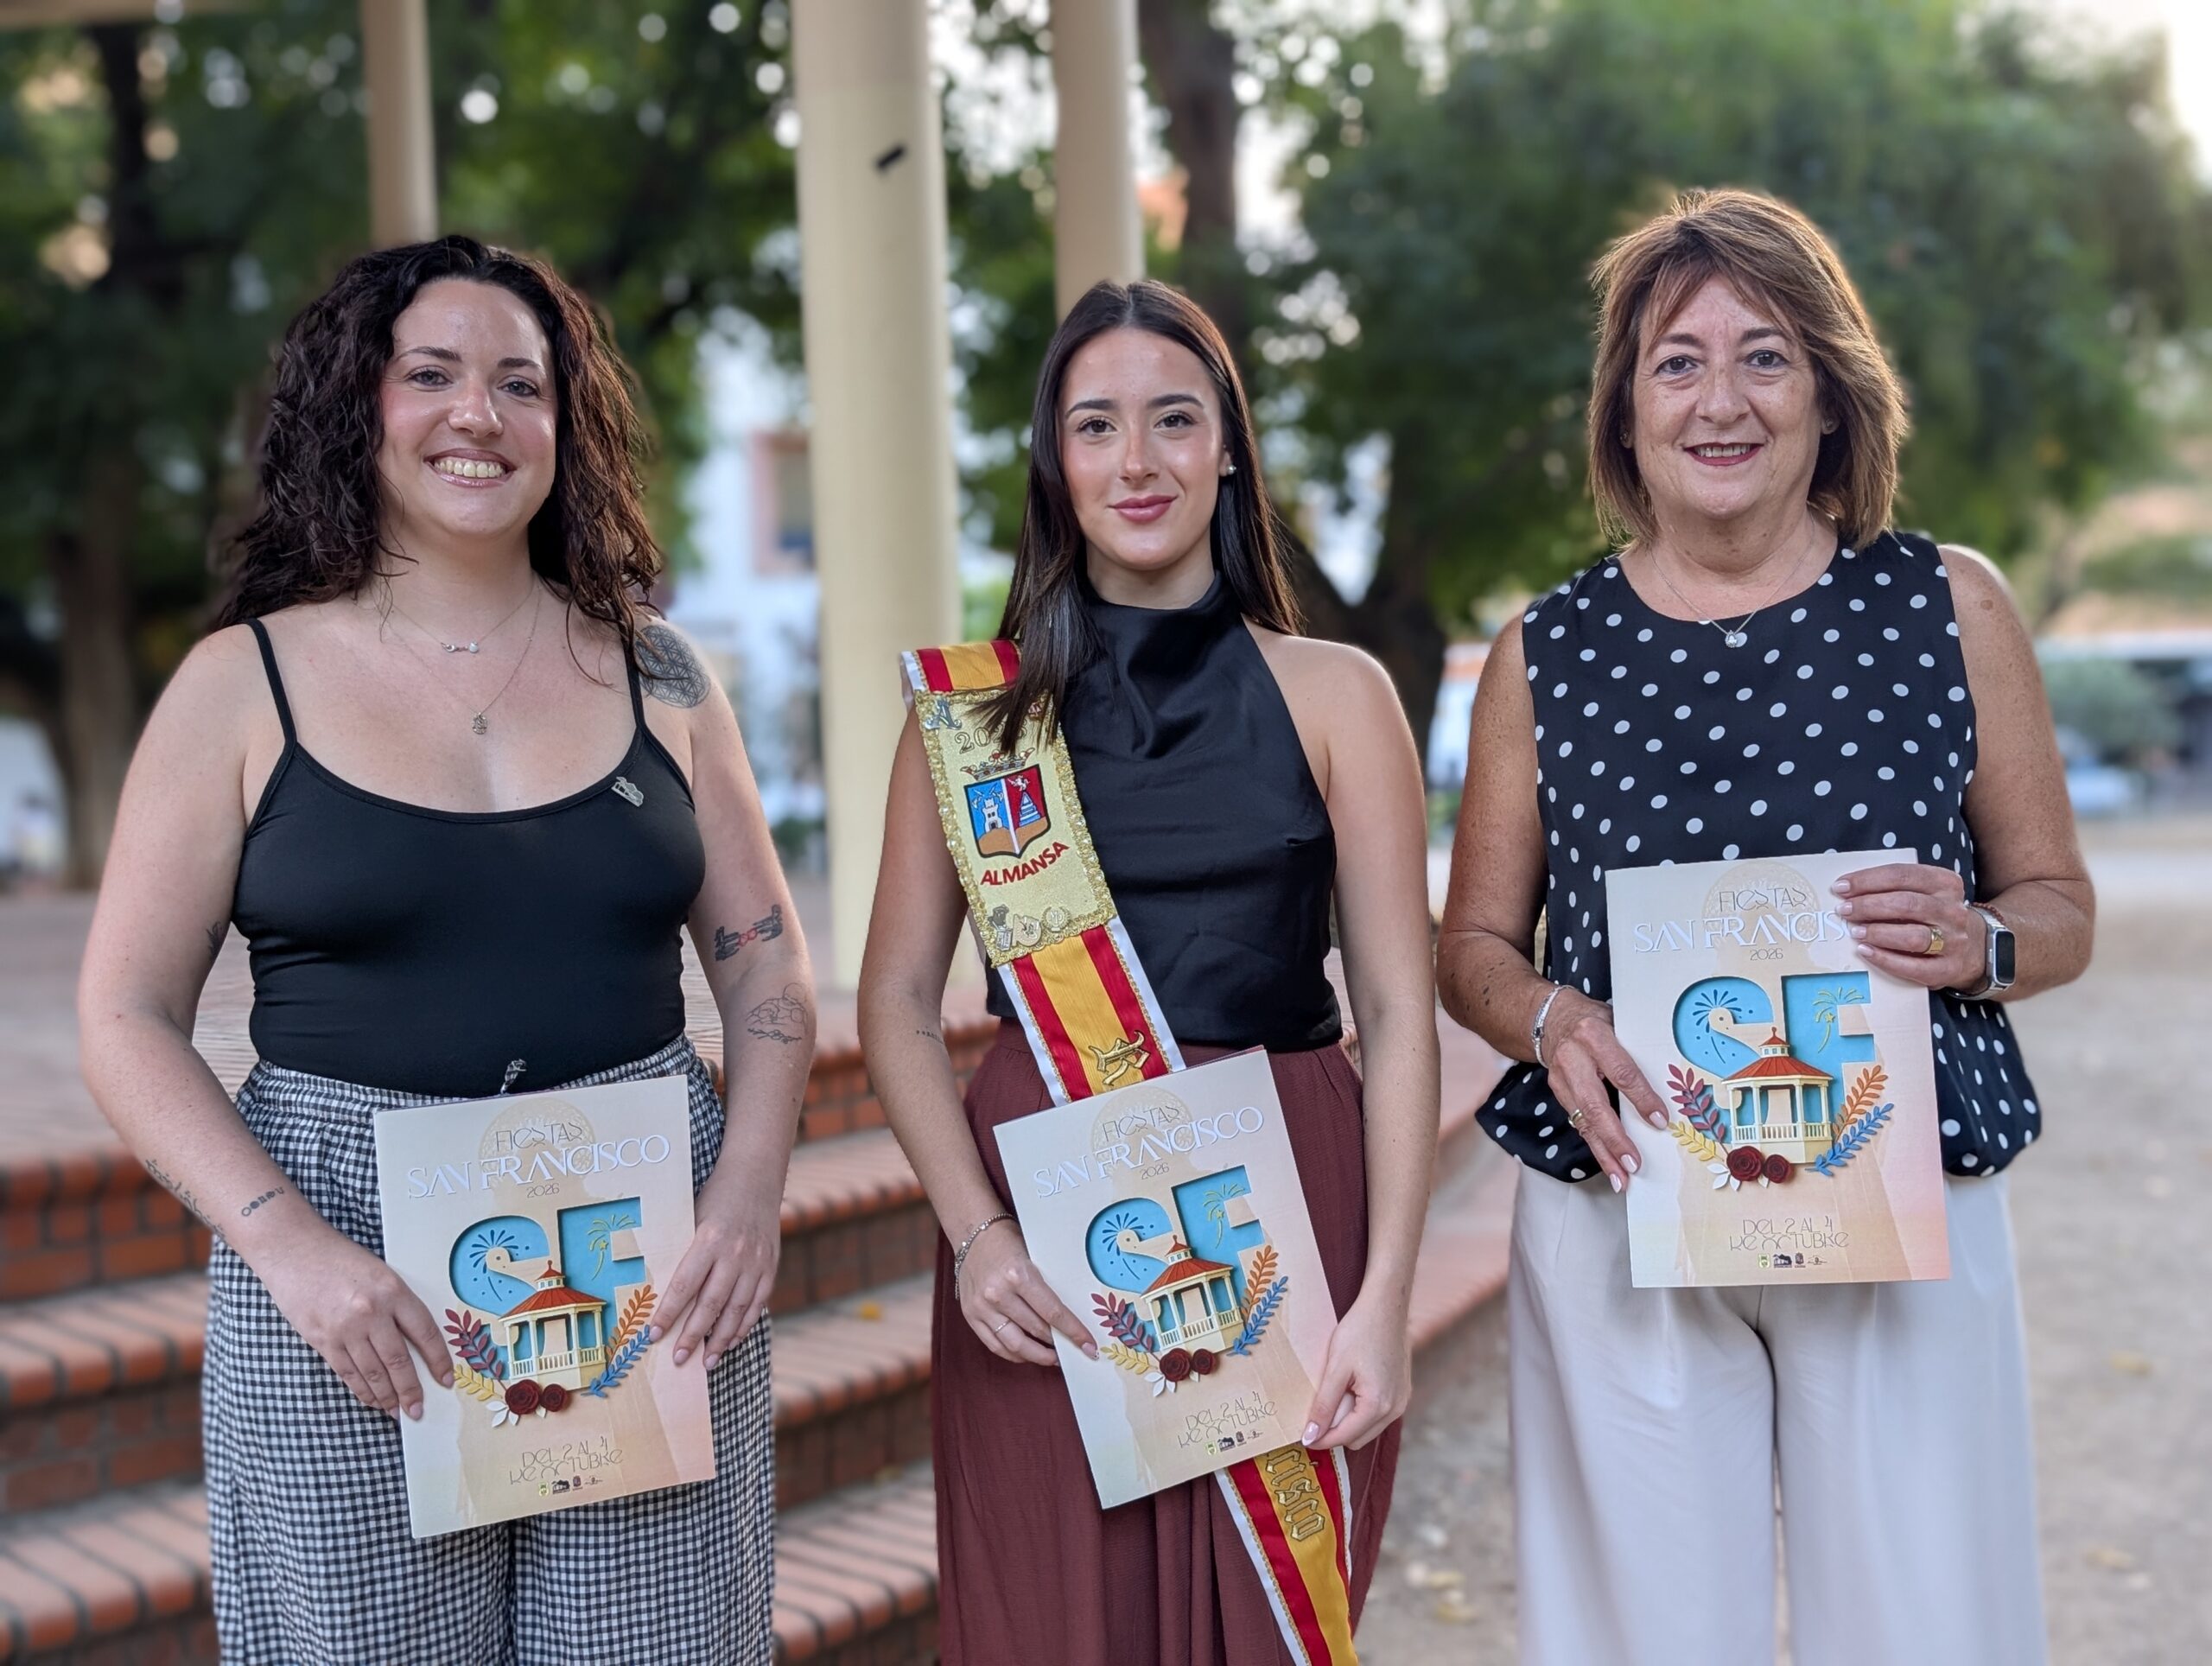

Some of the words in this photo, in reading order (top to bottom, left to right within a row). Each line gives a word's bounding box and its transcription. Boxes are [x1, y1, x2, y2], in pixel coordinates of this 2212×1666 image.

[980, 842, 1070, 886] ALMANSA
[1633, 920, 1695, 953] SAN
[1702, 911, 1852, 949] FRANCIS
[1750, 948, 1783, 961] 2026
[1033, 1154, 1093, 1199] SAN
[1092, 1106, 1264, 1180] FRANCISCO
[407, 1160, 472, 1199] SAN
[480, 1135, 671, 1191] FRANCISCO
[1141, 1162, 1170, 1180] 2026
[526, 1183, 560, 1199] 2026
[1784, 1218, 1796, 1234] 2
[1801, 1218, 1821, 1233] AL
[1220, 1402, 1231, 1418] 2
[562, 1443, 574, 1463] 2
